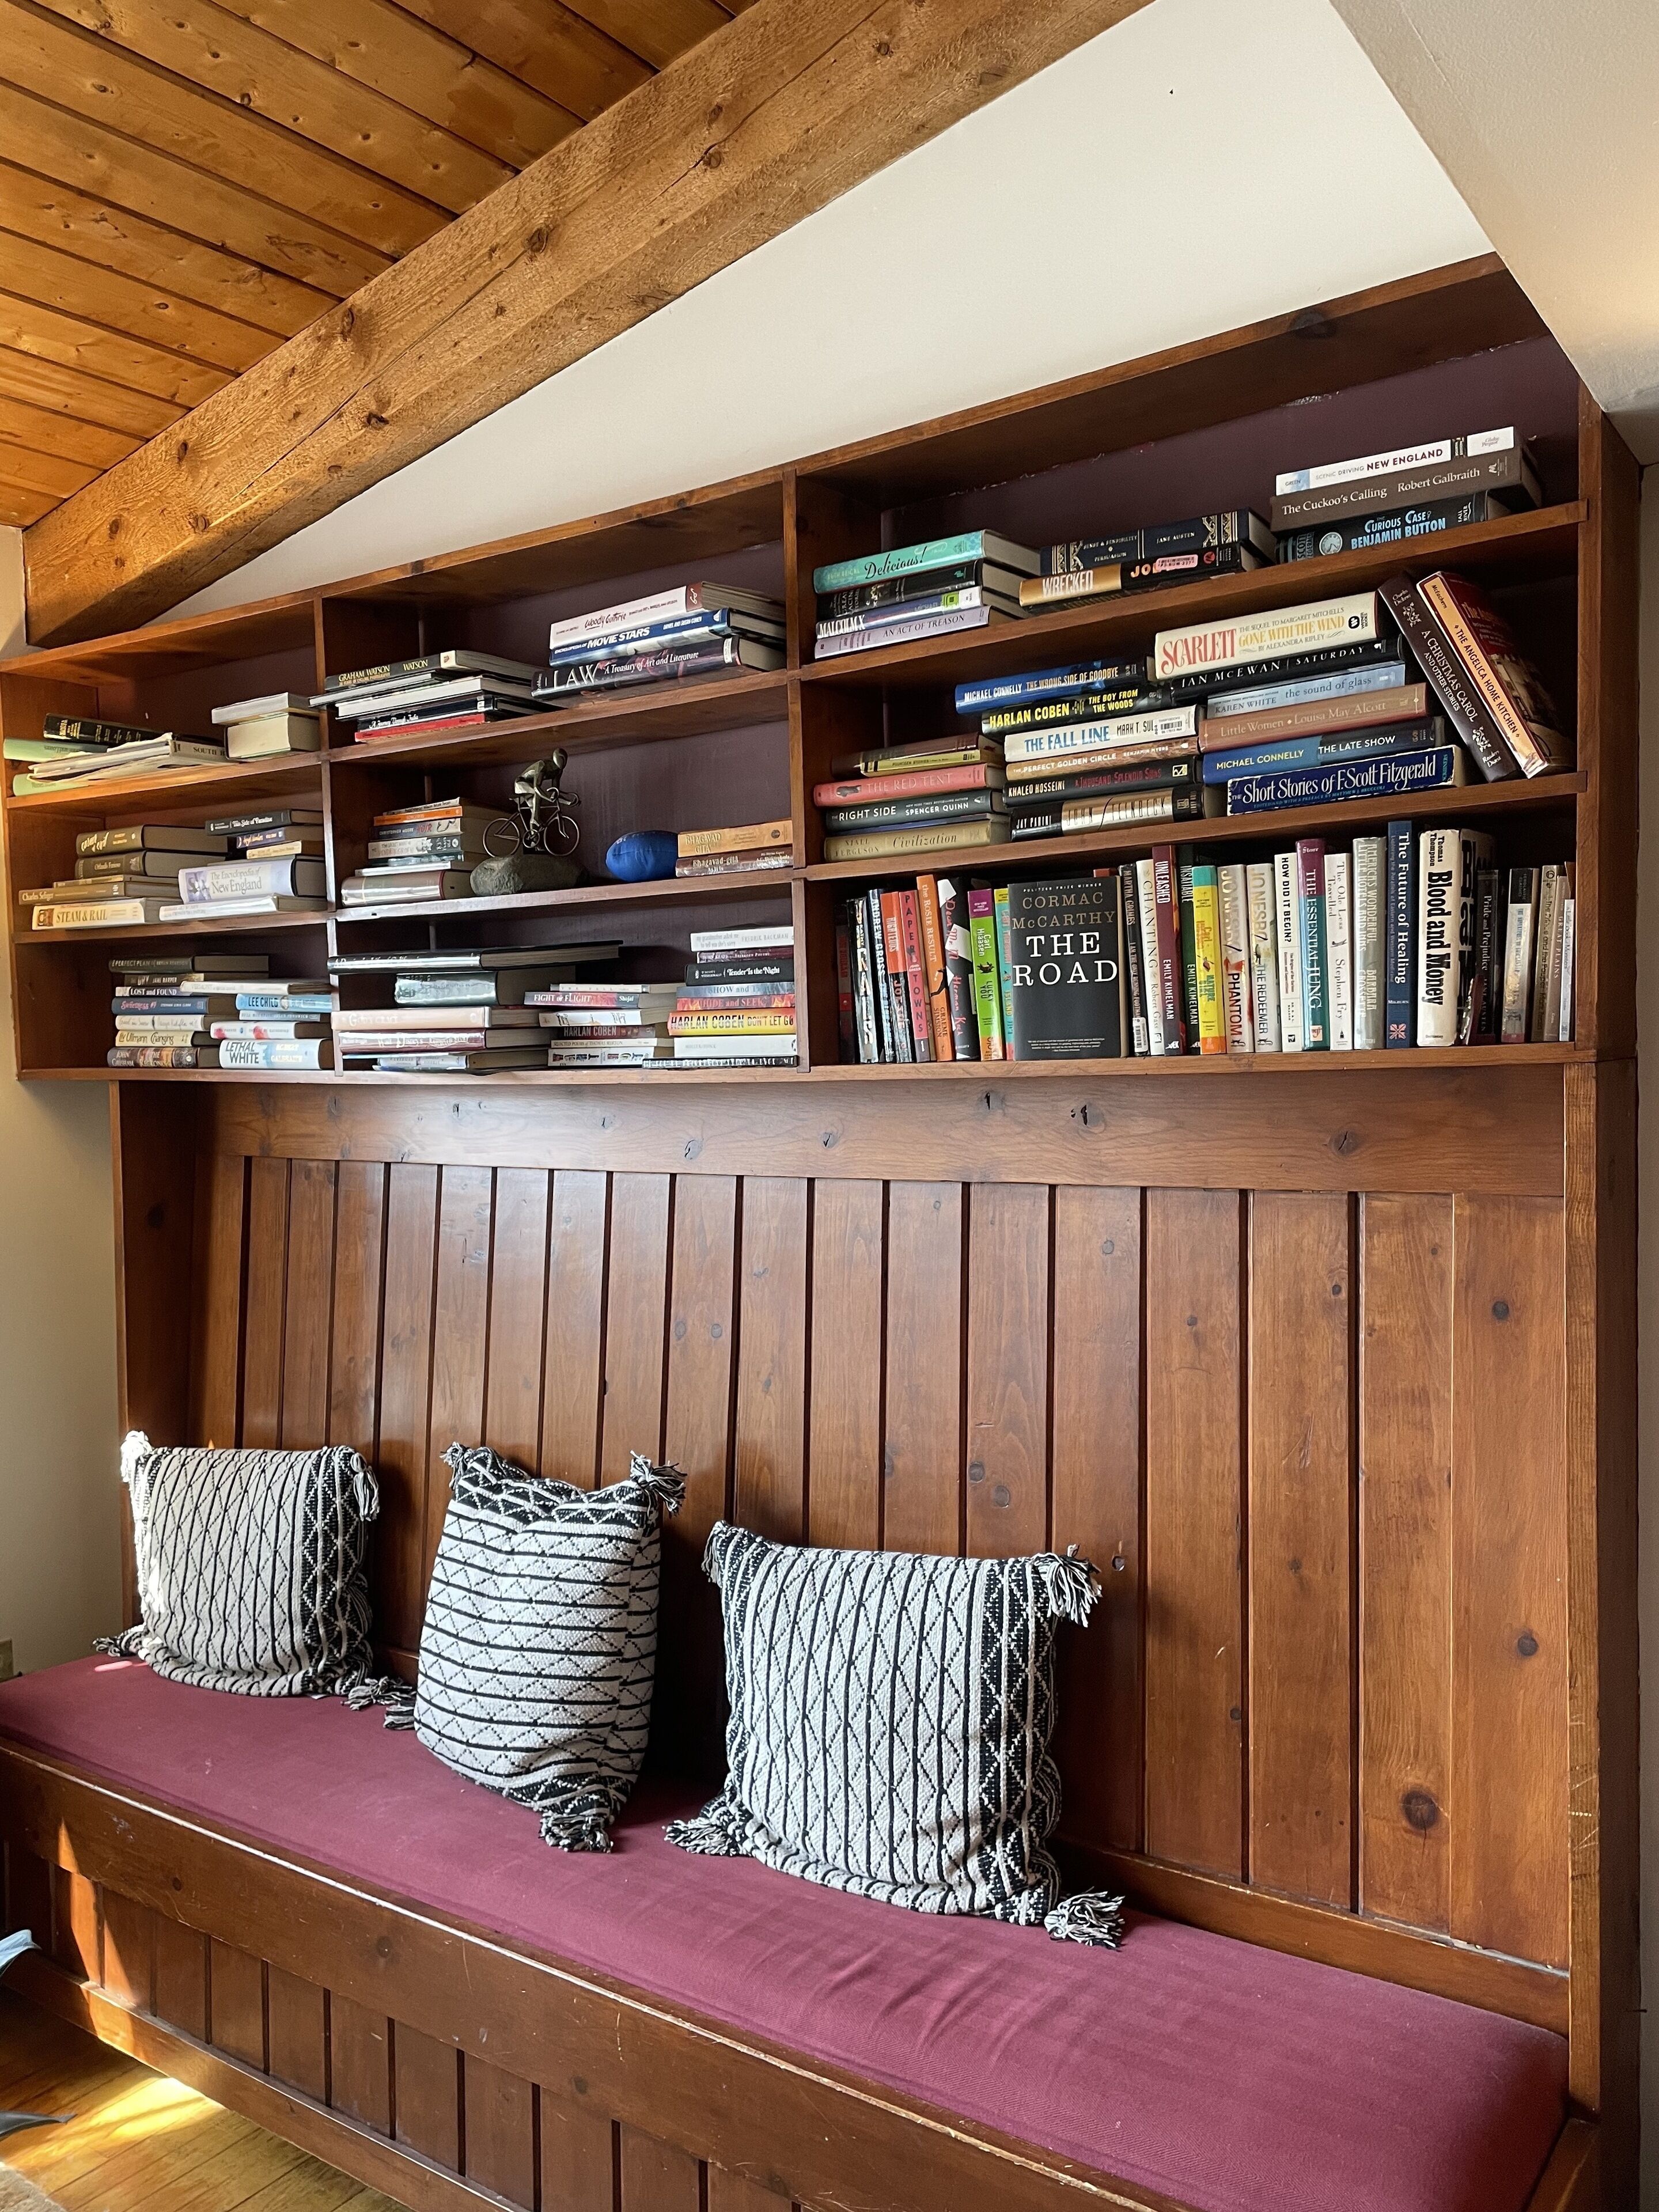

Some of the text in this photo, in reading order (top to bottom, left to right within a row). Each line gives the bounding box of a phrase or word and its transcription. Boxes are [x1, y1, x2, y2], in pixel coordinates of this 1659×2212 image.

[1338, 448, 1443, 476] DRIVING NEW ENGLAND
[1282, 468, 1480, 516] The Cuckoo's Calling Robert Galbraith
[1351, 517, 1446, 550] BENJAMIN BUTTON
[1365, 510, 1427, 533] CURIOUS CASE
[864, 546, 927, 579] Delicious!
[1042, 569, 1093, 599] WRECKED
[586, 627, 650, 649] MOVIE STARS
[896, 615, 965, 635] ACT OF TREASON
[1239, 616, 1345, 647] GONE WITH THE WIND
[611, 651, 699, 674] Treasury of Art and Literature
[1161, 628, 1237, 675] SCARLETT
[338, 659, 428, 682] GRAHAM WATSON WATSON
[553, 662, 599, 690] LAW
[1181, 646, 1365, 688] IAN SATURDAY
[1428, 636, 1479, 722] CHRISTMAS CAROL
[964, 666, 1119, 703] MICHAEL CONNELLY SIDE GOODBYE
[1285, 676, 1372, 699] the sound of glass
[1456, 628, 1519, 734] THE ANGELICA HOME KITCHEN
[989, 688, 1138, 728] HARLAN COBEN THE BOY FROM
[1093, 699, 1134, 714] THE WOODS
[1221, 707, 1350, 737] Little Women May
[192, 747, 217, 756] SOUTH
[1024, 725, 1111, 753] THE FALL LINE
[1022, 753, 1116, 773] PERFECT GOLDEN CIRCLE
[1216, 735, 1396, 770] MICHAEL CONNELLY THE LATE SHOW
[866, 773, 953, 793] THE RED TENT
[1243, 755, 1436, 804] Short Stories of Fitzgerald
[839, 806, 896, 821] RIGHT SIDE
[906, 802, 968, 816] SPENCER QUINN
[685, 832, 722, 845] BHAGAVAD
[694, 844, 711, 854] GITA
[893, 833, 957, 849] Civilization
[1281, 857, 1289, 880] HOW
[211, 877, 262, 895] New England
[1155, 861, 1171, 904] UNLEASHED
[1305, 869, 1317, 896] THE
[1022, 892, 1104, 909] CORMAC
[1283, 902, 1290, 911] IT
[1394, 832, 1410, 984] The Future of Healing
[56, 909, 108, 923] STEAM & RAIL
[923, 895, 937, 963] ROSIE RESULT
[1012, 911, 1116, 930] McCARTHY
[1143, 880, 1158, 968] CHANTING
[1283, 912, 1291, 943] BEGIN?
[977, 928, 985, 956] Hiaasen
[983, 934, 991, 949] Carl
[1026, 931, 1100, 958] THE
[1421, 870, 1453, 1005] Blood and Money
[1480, 895, 1492, 971] Pride Prejudice
[763, 967, 779, 975] Night
[1012, 960, 1118, 986] ROAD
[248, 997, 278, 1007] LEE CHILD
[533, 993, 591, 1002] FIGHT FLIGHT
[726, 997, 764, 1007] and SEEK
[1163, 959, 1174, 1020] EMILY KIMELMAN
[1187, 964, 1198, 1024] EMILY KIMELMAN
[1257, 965, 1268, 1034] THE REDEEMER
[1228, 972, 1243, 1036] PHANTOM
[564, 1026, 617, 1037] HARLAN COBEN
[671, 1015, 794, 1029] HARLAN COBEN DON'T LET GO
[151, 1032, 174, 1045] Changing
[225, 1041, 255, 1052] LETHAL
[230, 1052, 259, 1064] WHITE
